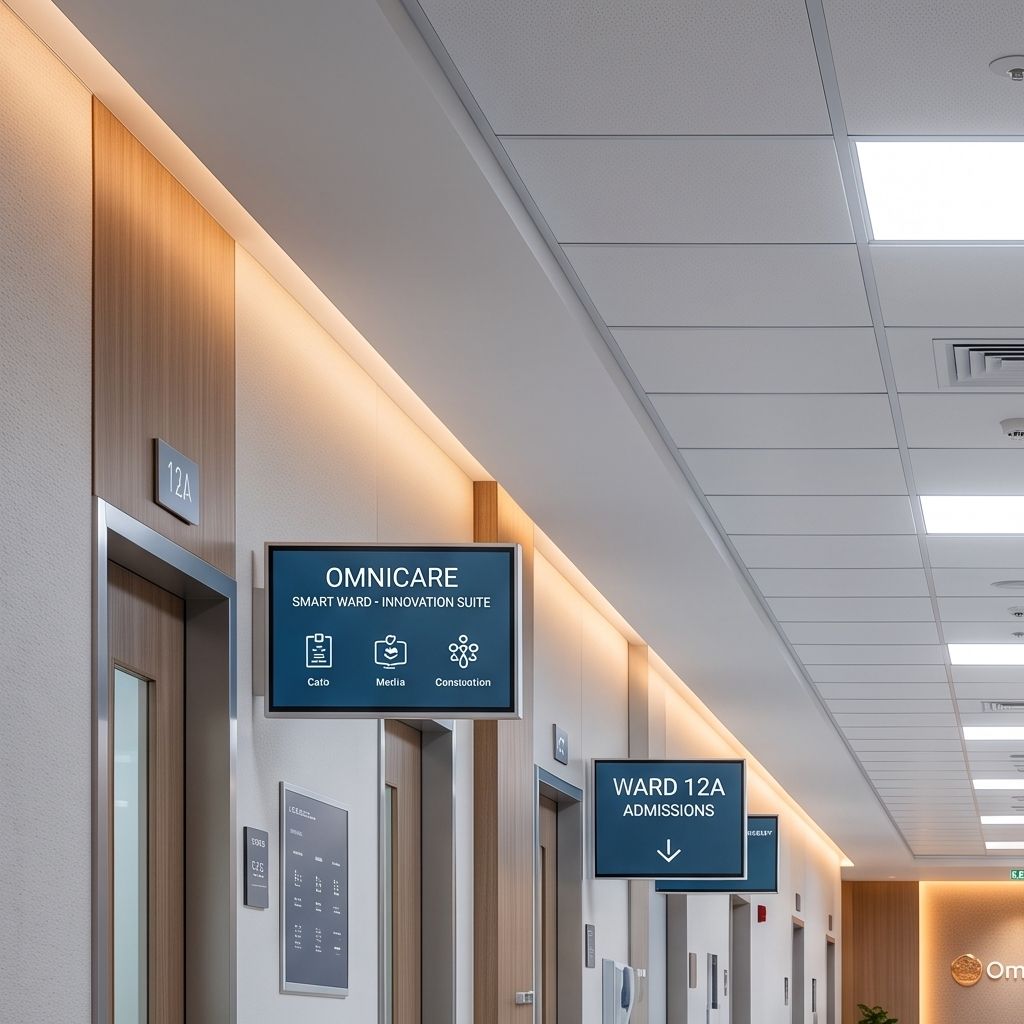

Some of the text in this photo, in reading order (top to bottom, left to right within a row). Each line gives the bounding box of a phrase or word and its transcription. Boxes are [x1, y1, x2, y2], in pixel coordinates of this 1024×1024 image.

[167, 461, 192, 503] 12A
[326, 567, 459, 588] OMNICARE
[292, 596, 335, 608] SMART
[337, 596, 372, 608] WARD
[382, 596, 454, 608] INNOVATION
[457, 596, 491, 608] SUITE
[376, 677, 406, 687] Media
[612, 777, 726, 796] WARD 12A
[622, 803, 715, 817] ADMISSIONS
